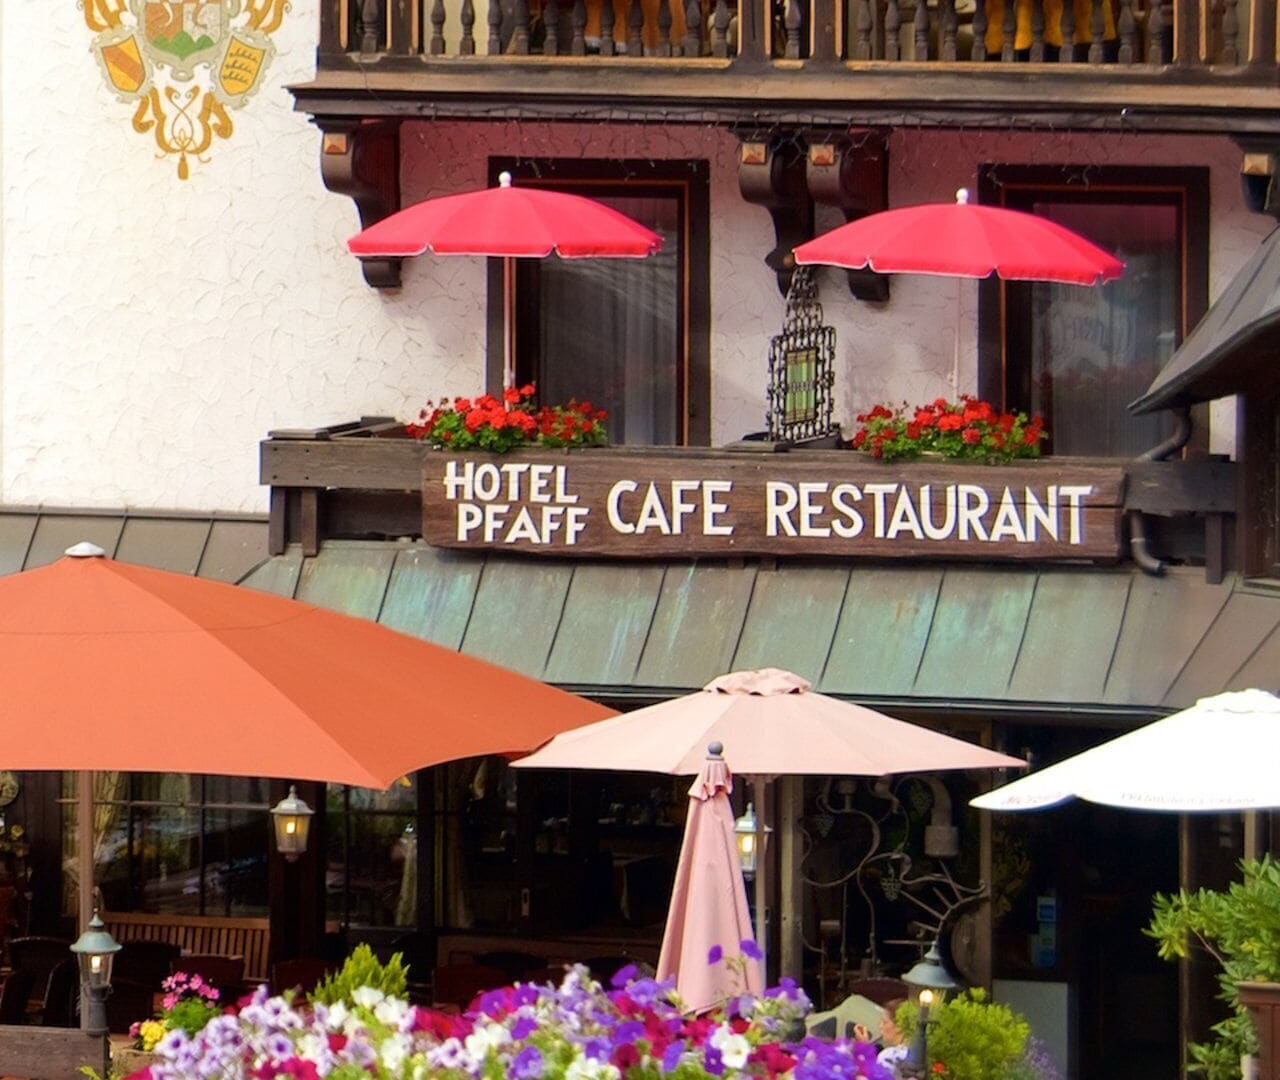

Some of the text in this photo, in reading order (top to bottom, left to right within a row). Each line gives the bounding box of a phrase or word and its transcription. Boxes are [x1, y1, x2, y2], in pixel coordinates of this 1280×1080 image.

[443, 460, 578, 505] HOTEL
[456, 502, 589, 545] PFAFF
[606, 479, 1093, 545] CAFE RESTAURANT
